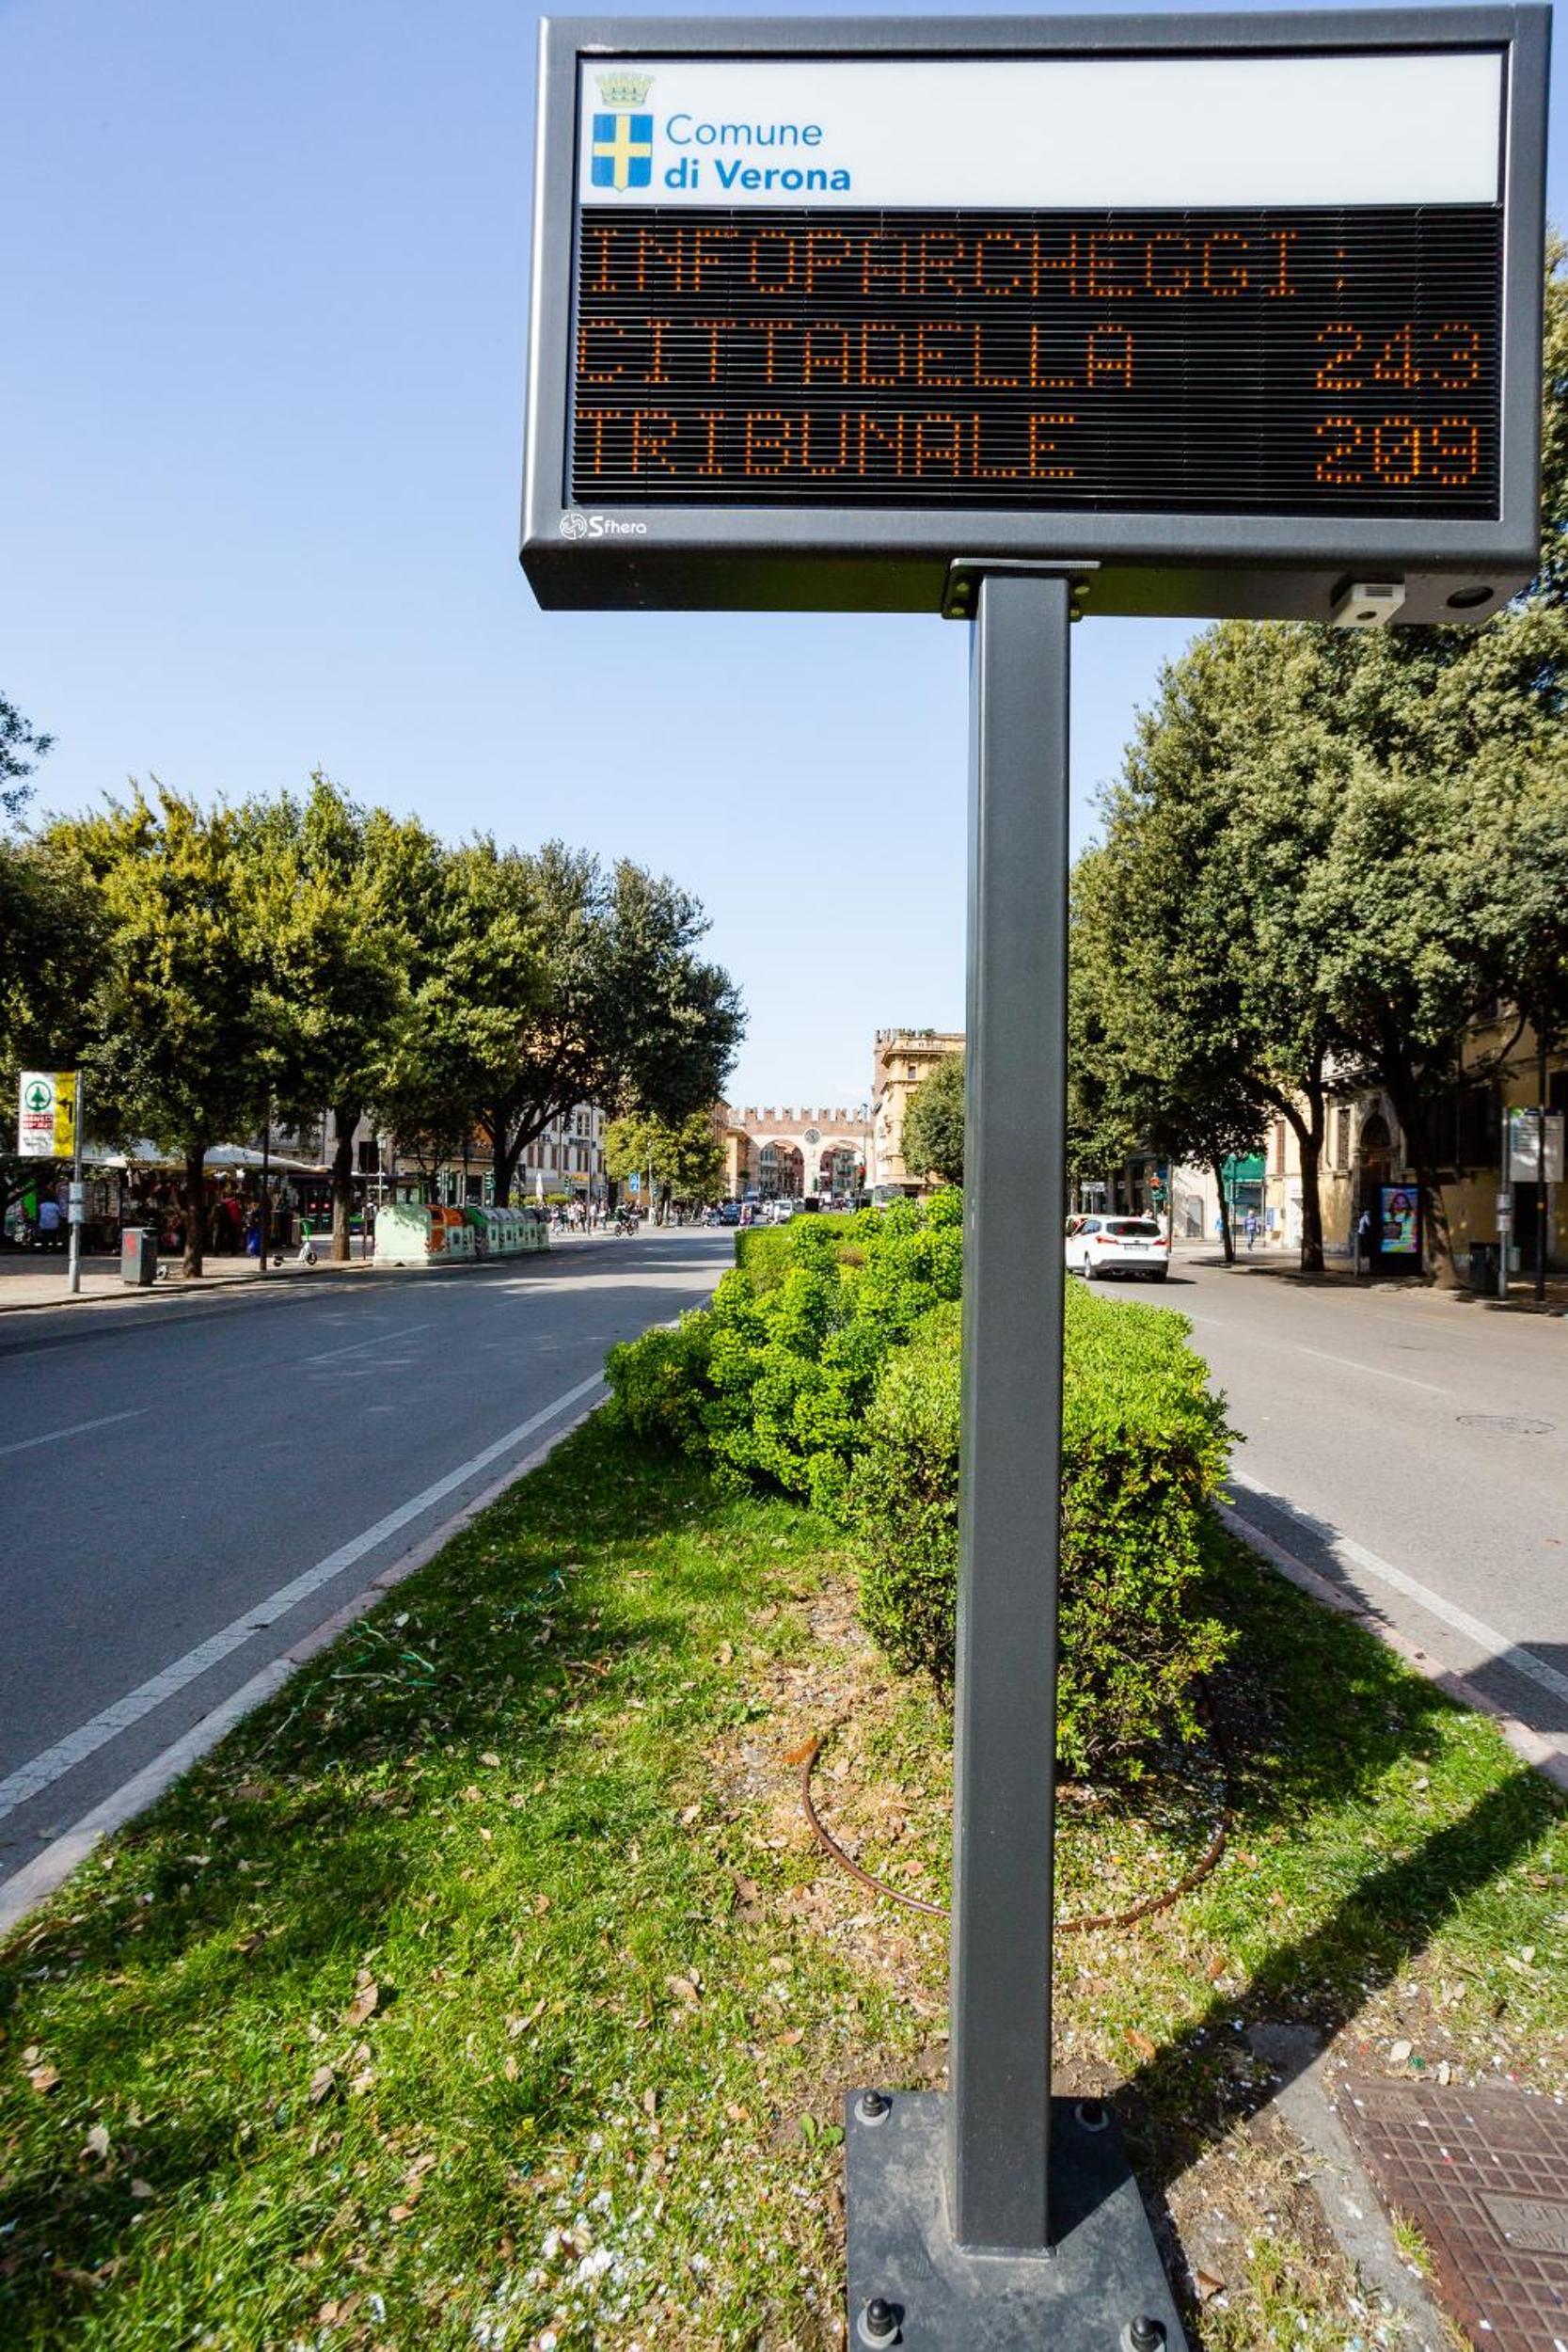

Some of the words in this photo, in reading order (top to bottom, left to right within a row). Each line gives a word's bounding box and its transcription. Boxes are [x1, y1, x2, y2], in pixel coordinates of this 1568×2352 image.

[665, 114, 822, 147] Comune
[664, 158, 700, 190] di
[714, 159, 851, 192] Verona
[579, 318, 1132, 388] CITTADELLA
[1316, 323, 1481, 389] 243
[575, 409, 1075, 479] TRIBUNALE
[1315, 416, 1480, 485] 209
